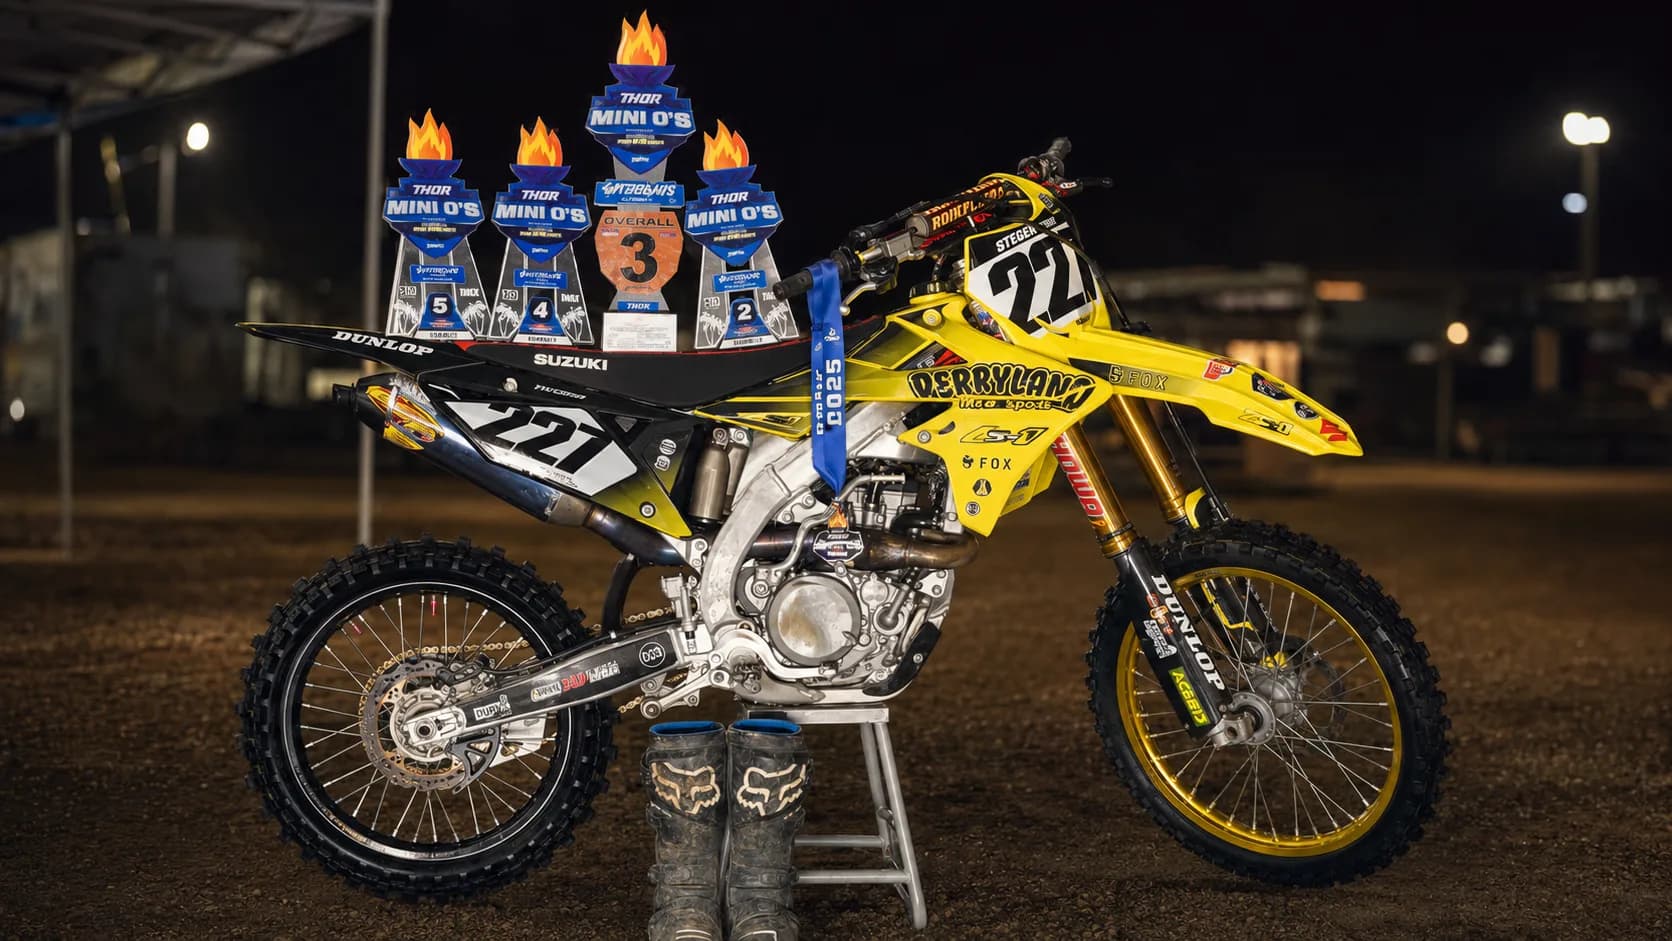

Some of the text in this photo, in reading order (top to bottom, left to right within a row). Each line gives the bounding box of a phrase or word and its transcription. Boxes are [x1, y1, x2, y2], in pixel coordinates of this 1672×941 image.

[620, 92, 662, 104] THOR
[590, 110, 692, 128] MINI O'S
[412, 184, 452, 196] THOR
[521, 190, 560, 201] THOR
[710, 191, 749, 205] THOR
[387, 200, 480, 217] MINI O'S
[495, 204, 586, 223] MINI O'S
[687, 204, 778, 229] MINI O'S
[604, 217, 674, 227] OVERALL
[620, 232, 658, 283] 3
[432, 297, 448, 314] 5
[532, 301, 549, 319] 4
[737, 303, 752, 321] 2
[331, 330, 434, 356] DUNLOP
[533, 353, 608, 371] SUZUKI
[1127, 371, 1169, 391] FOX
[979, 457, 1012, 470] FOX
[1151, 574, 1225, 690] DUNLOP
